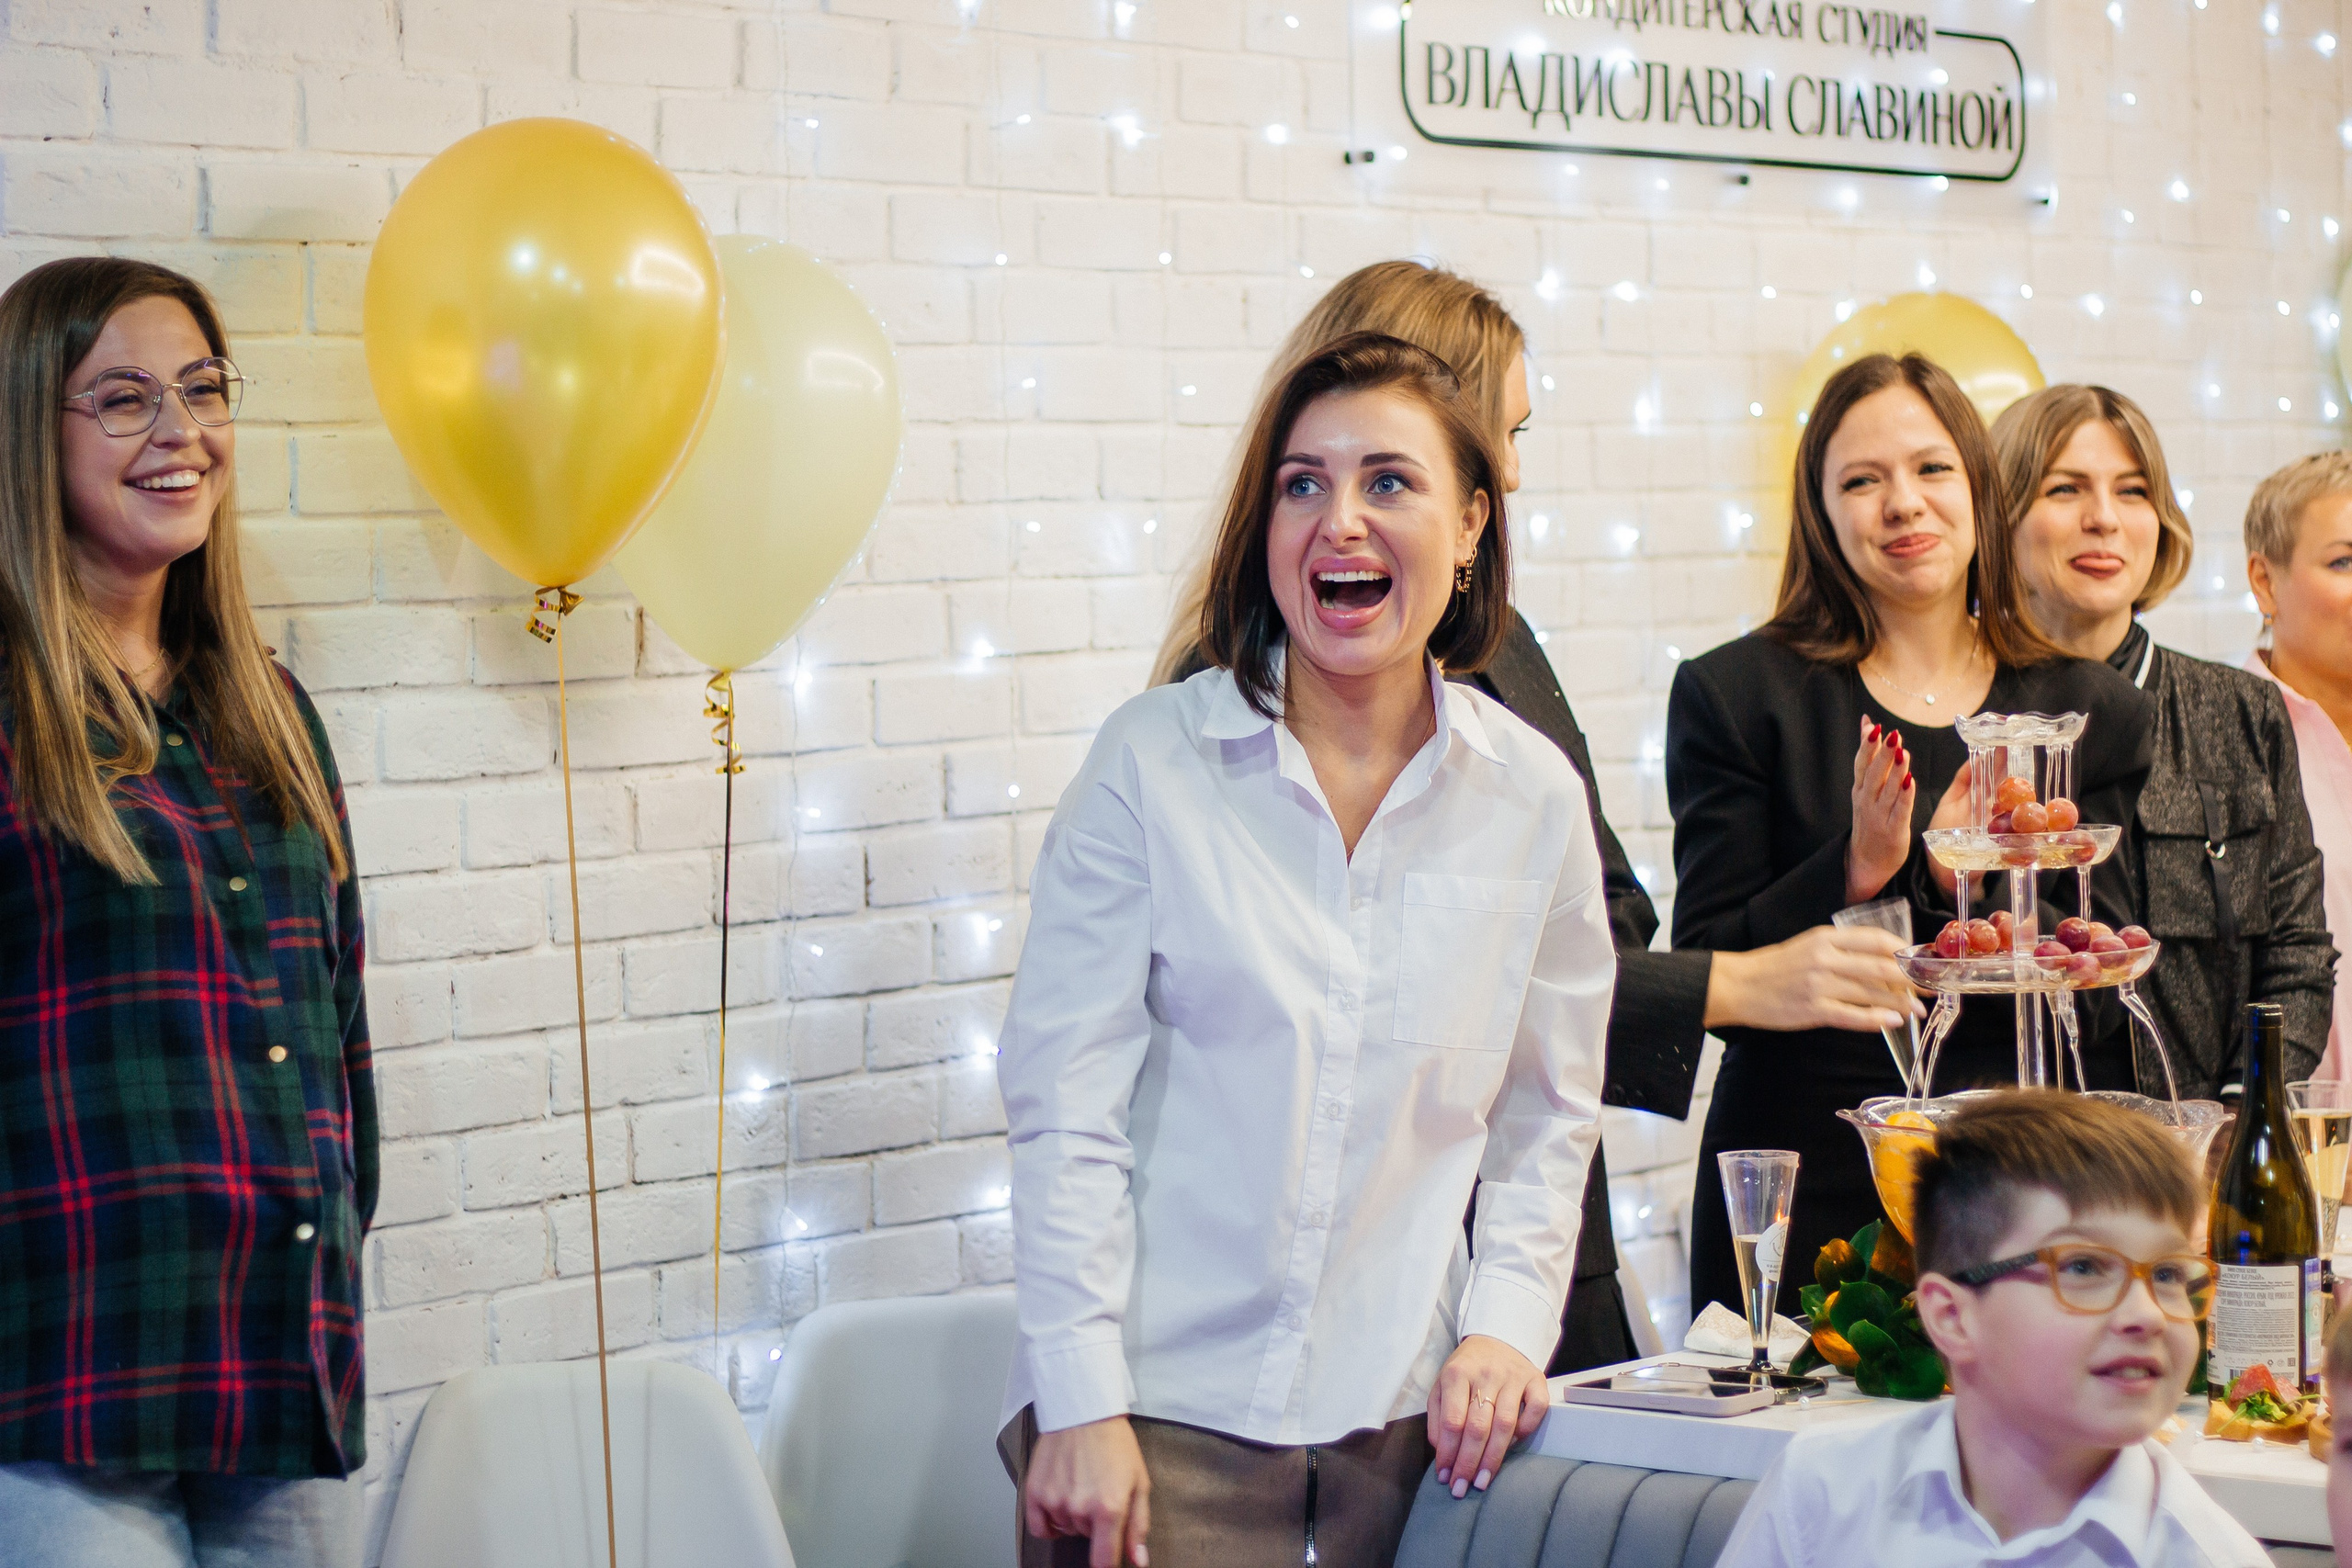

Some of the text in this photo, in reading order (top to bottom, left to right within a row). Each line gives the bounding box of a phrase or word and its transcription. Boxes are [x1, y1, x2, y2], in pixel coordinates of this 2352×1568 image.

[1817, 4, 1928, 58] СТУДИЯ
[1425, 41, 2013, 152] ВЛАДИСЛАВЫ СЛАВИНОЙ
